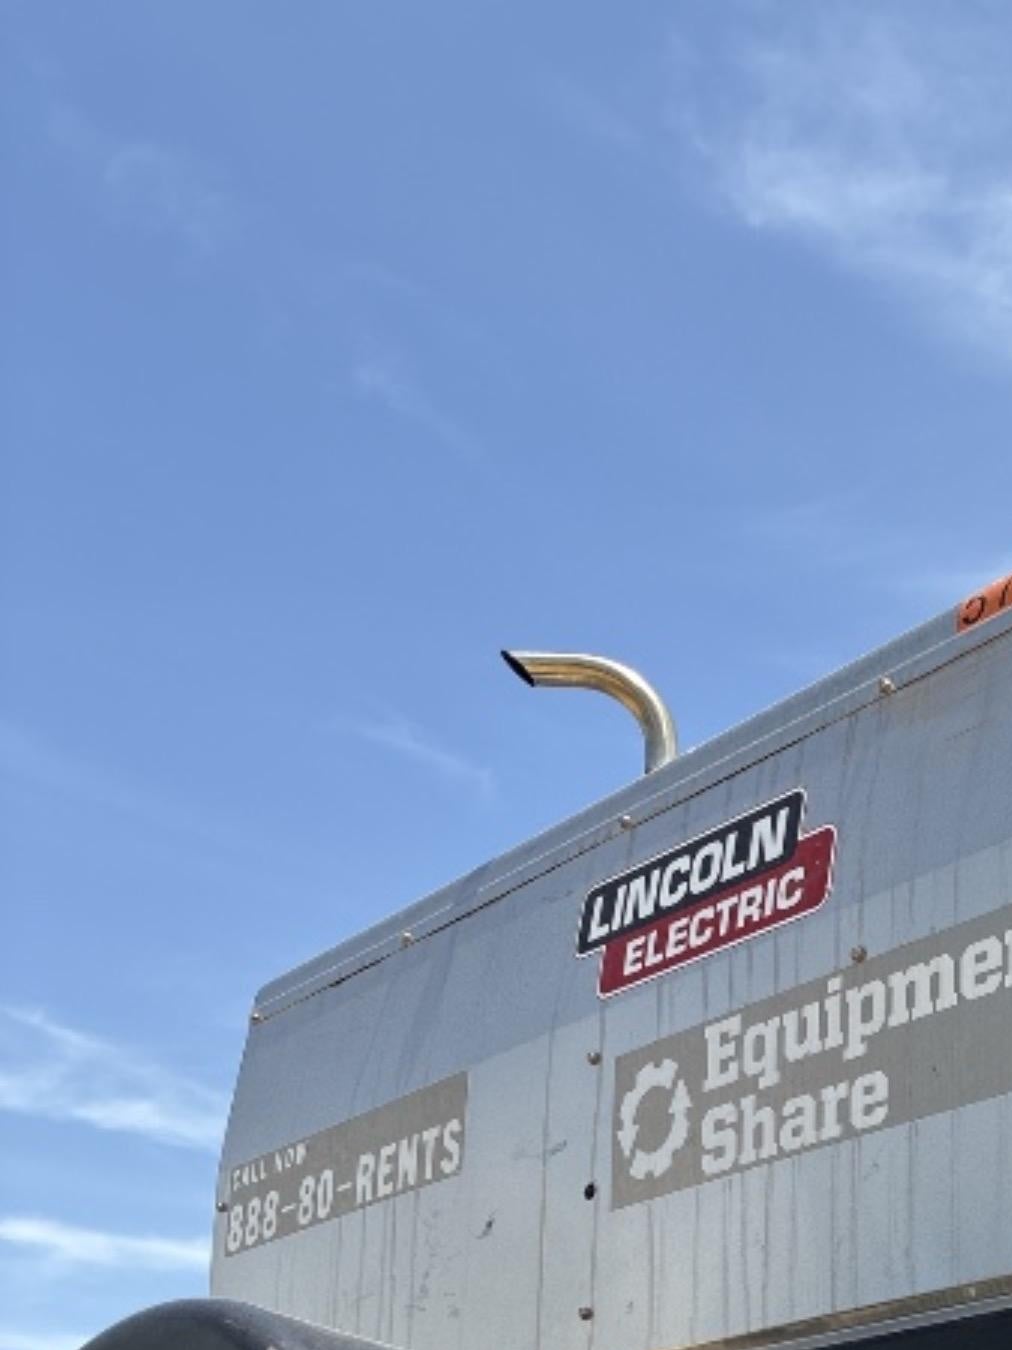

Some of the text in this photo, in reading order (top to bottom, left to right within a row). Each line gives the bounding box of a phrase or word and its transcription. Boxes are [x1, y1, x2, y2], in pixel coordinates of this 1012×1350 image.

[589, 806, 790, 940] LINCOLN
[622, 867, 808, 976] ELECTRIC
[700, 1068, 890, 1177] Share
[227, 1117, 463, 1253] 888-80-RENTS
